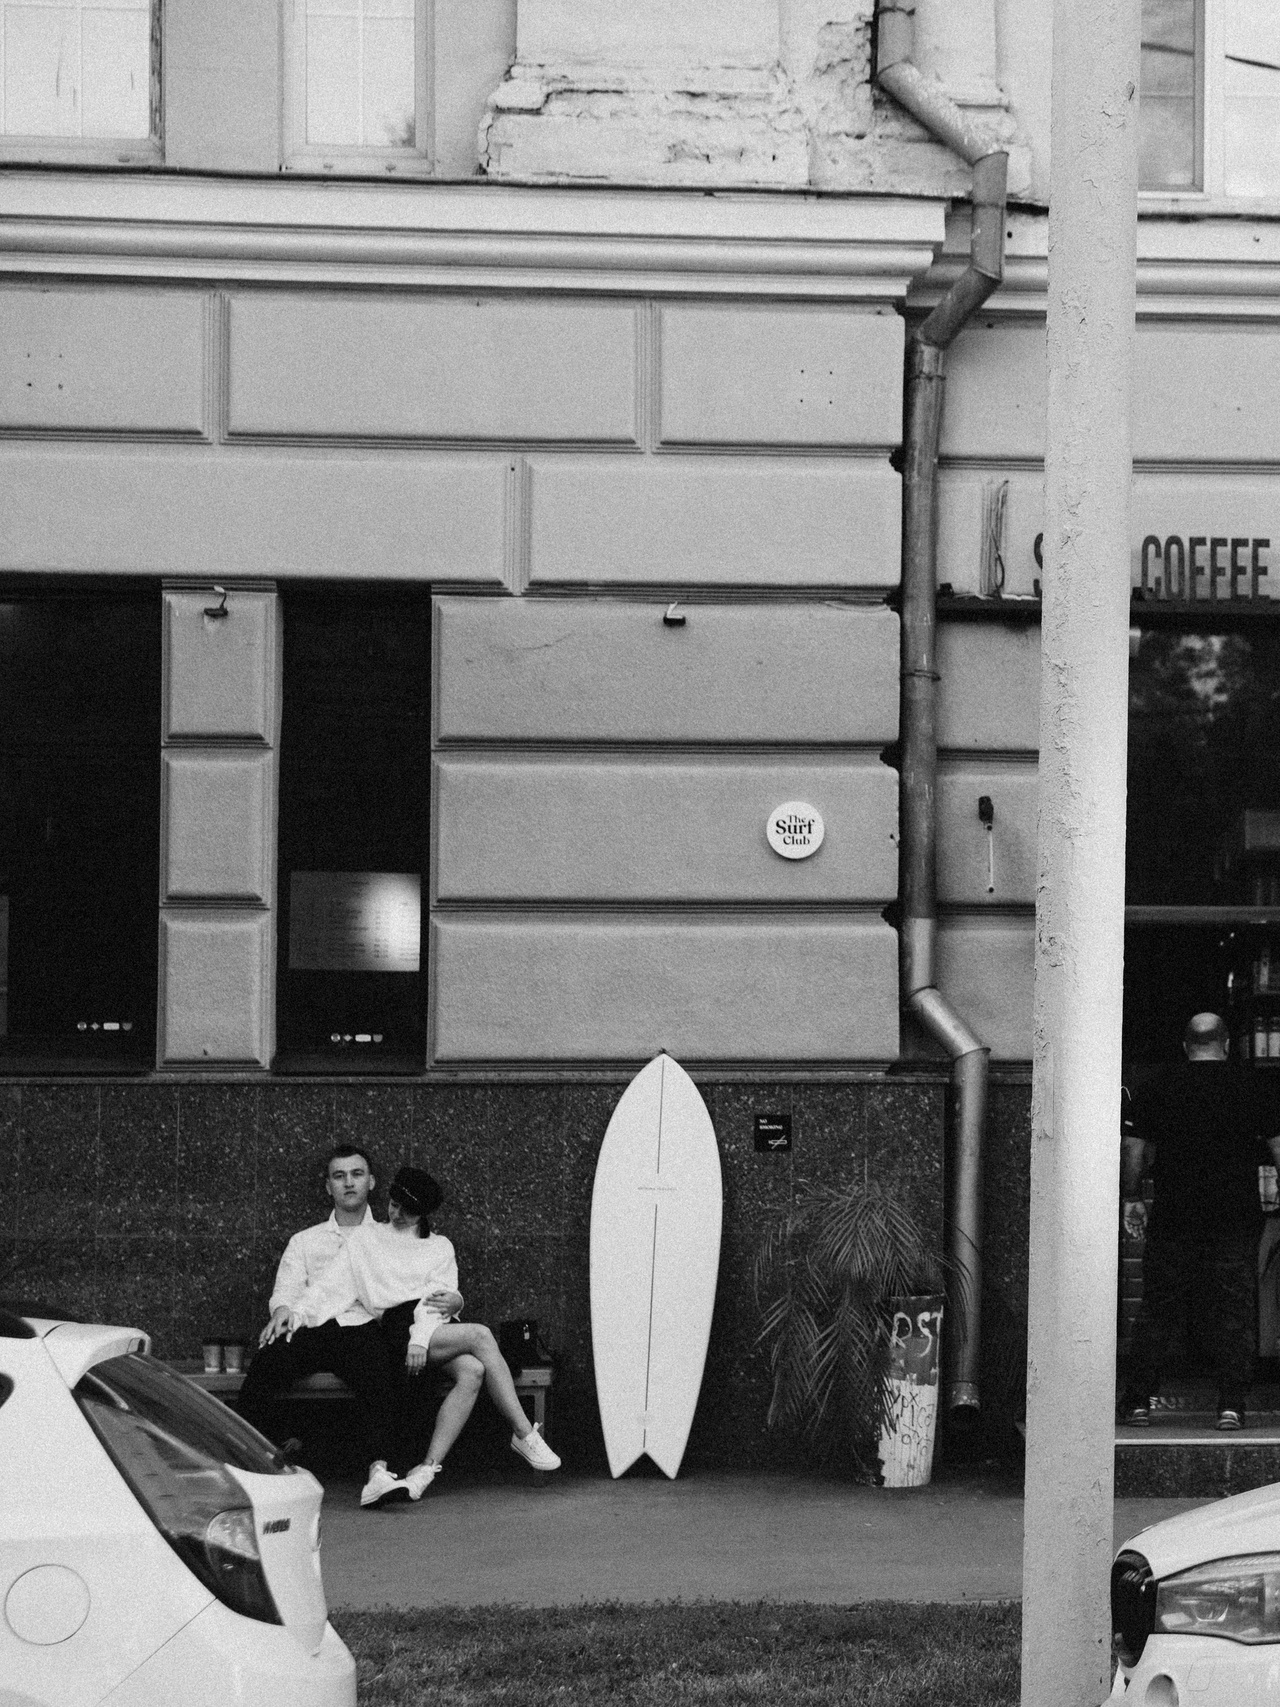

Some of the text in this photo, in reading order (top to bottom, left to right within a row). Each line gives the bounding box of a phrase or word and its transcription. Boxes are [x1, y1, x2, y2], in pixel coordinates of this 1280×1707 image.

[1141, 535, 1270, 600] COFFEE
[788, 814, 806, 823] The
[775, 819, 815, 834] Surf
[783, 835, 810, 845] Club
